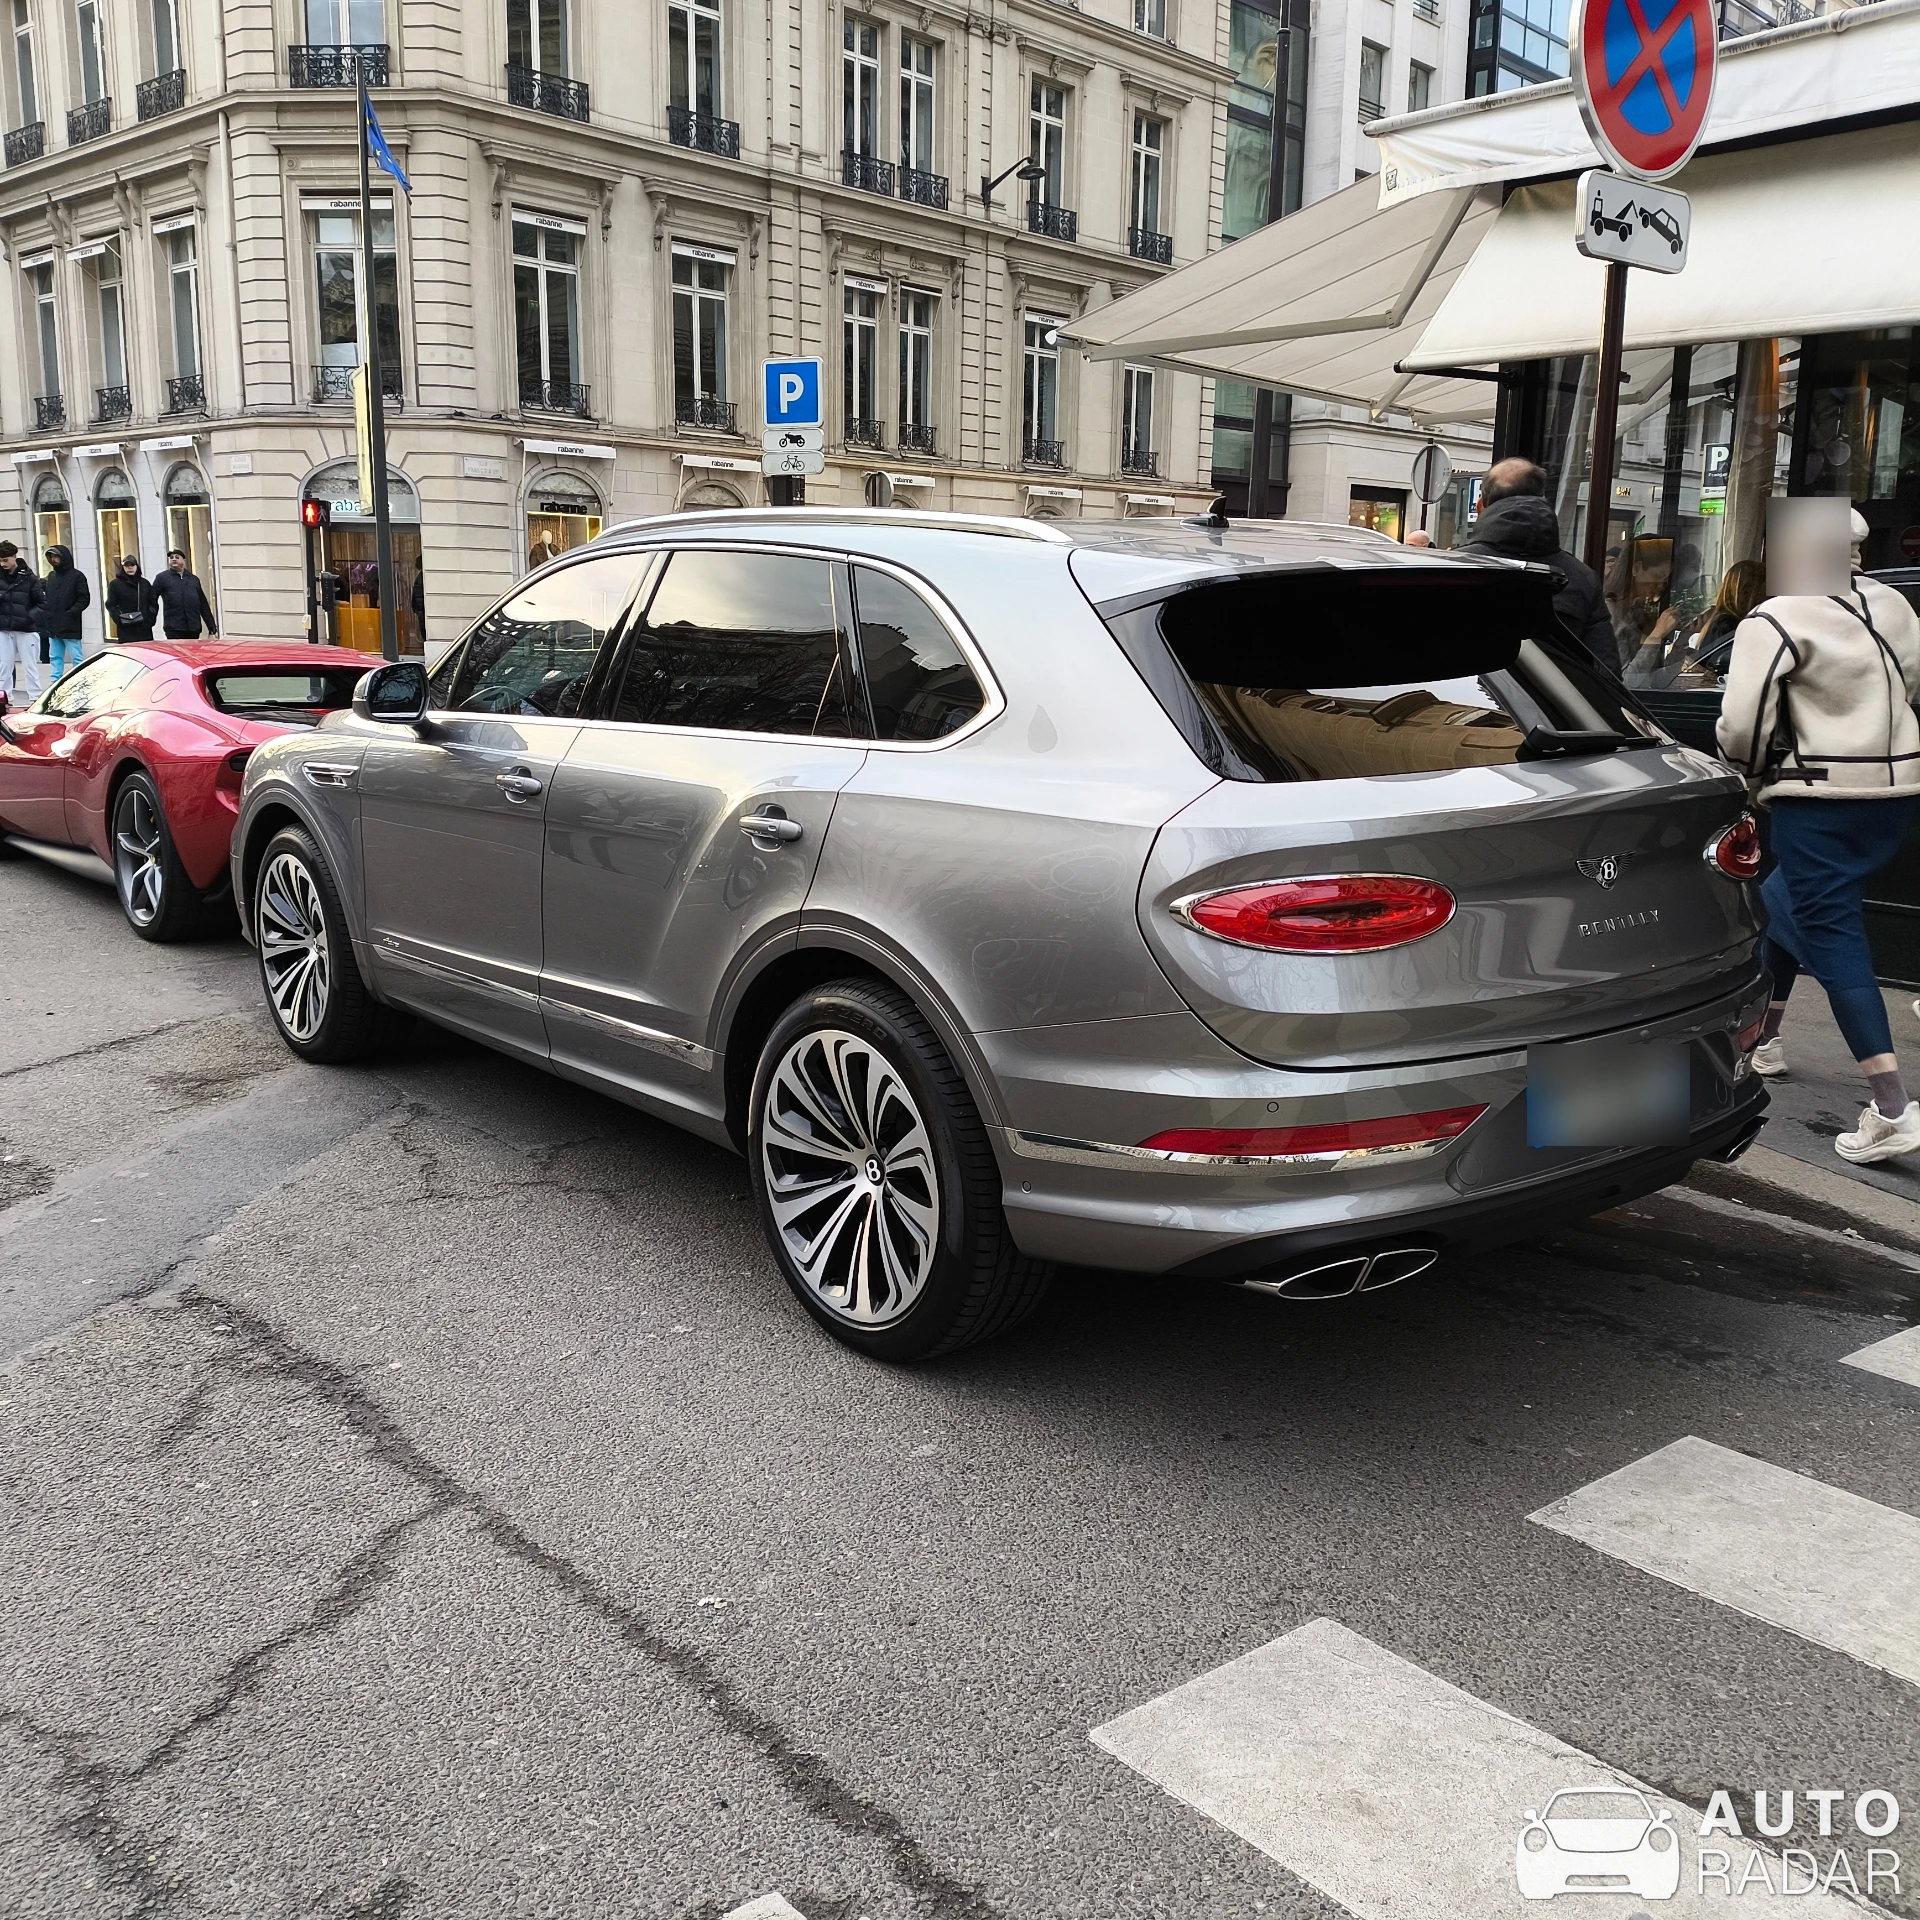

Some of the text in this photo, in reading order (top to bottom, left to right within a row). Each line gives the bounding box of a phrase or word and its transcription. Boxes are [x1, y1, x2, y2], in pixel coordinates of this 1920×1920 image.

[535, 216, 563, 229] rabanne
[692, 249, 716, 259] rabanne
[855, 279, 876, 290] rabanne
[780, 373, 804, 413] P
[557, 446, 584, 454] rabanne
[711, 459, 735, 468] rabanne
[894, 476, 914, 484] rabanne
[540, 501, 588, 515] rabanne
[1578, 909, 1660, 938] BENTLEY
